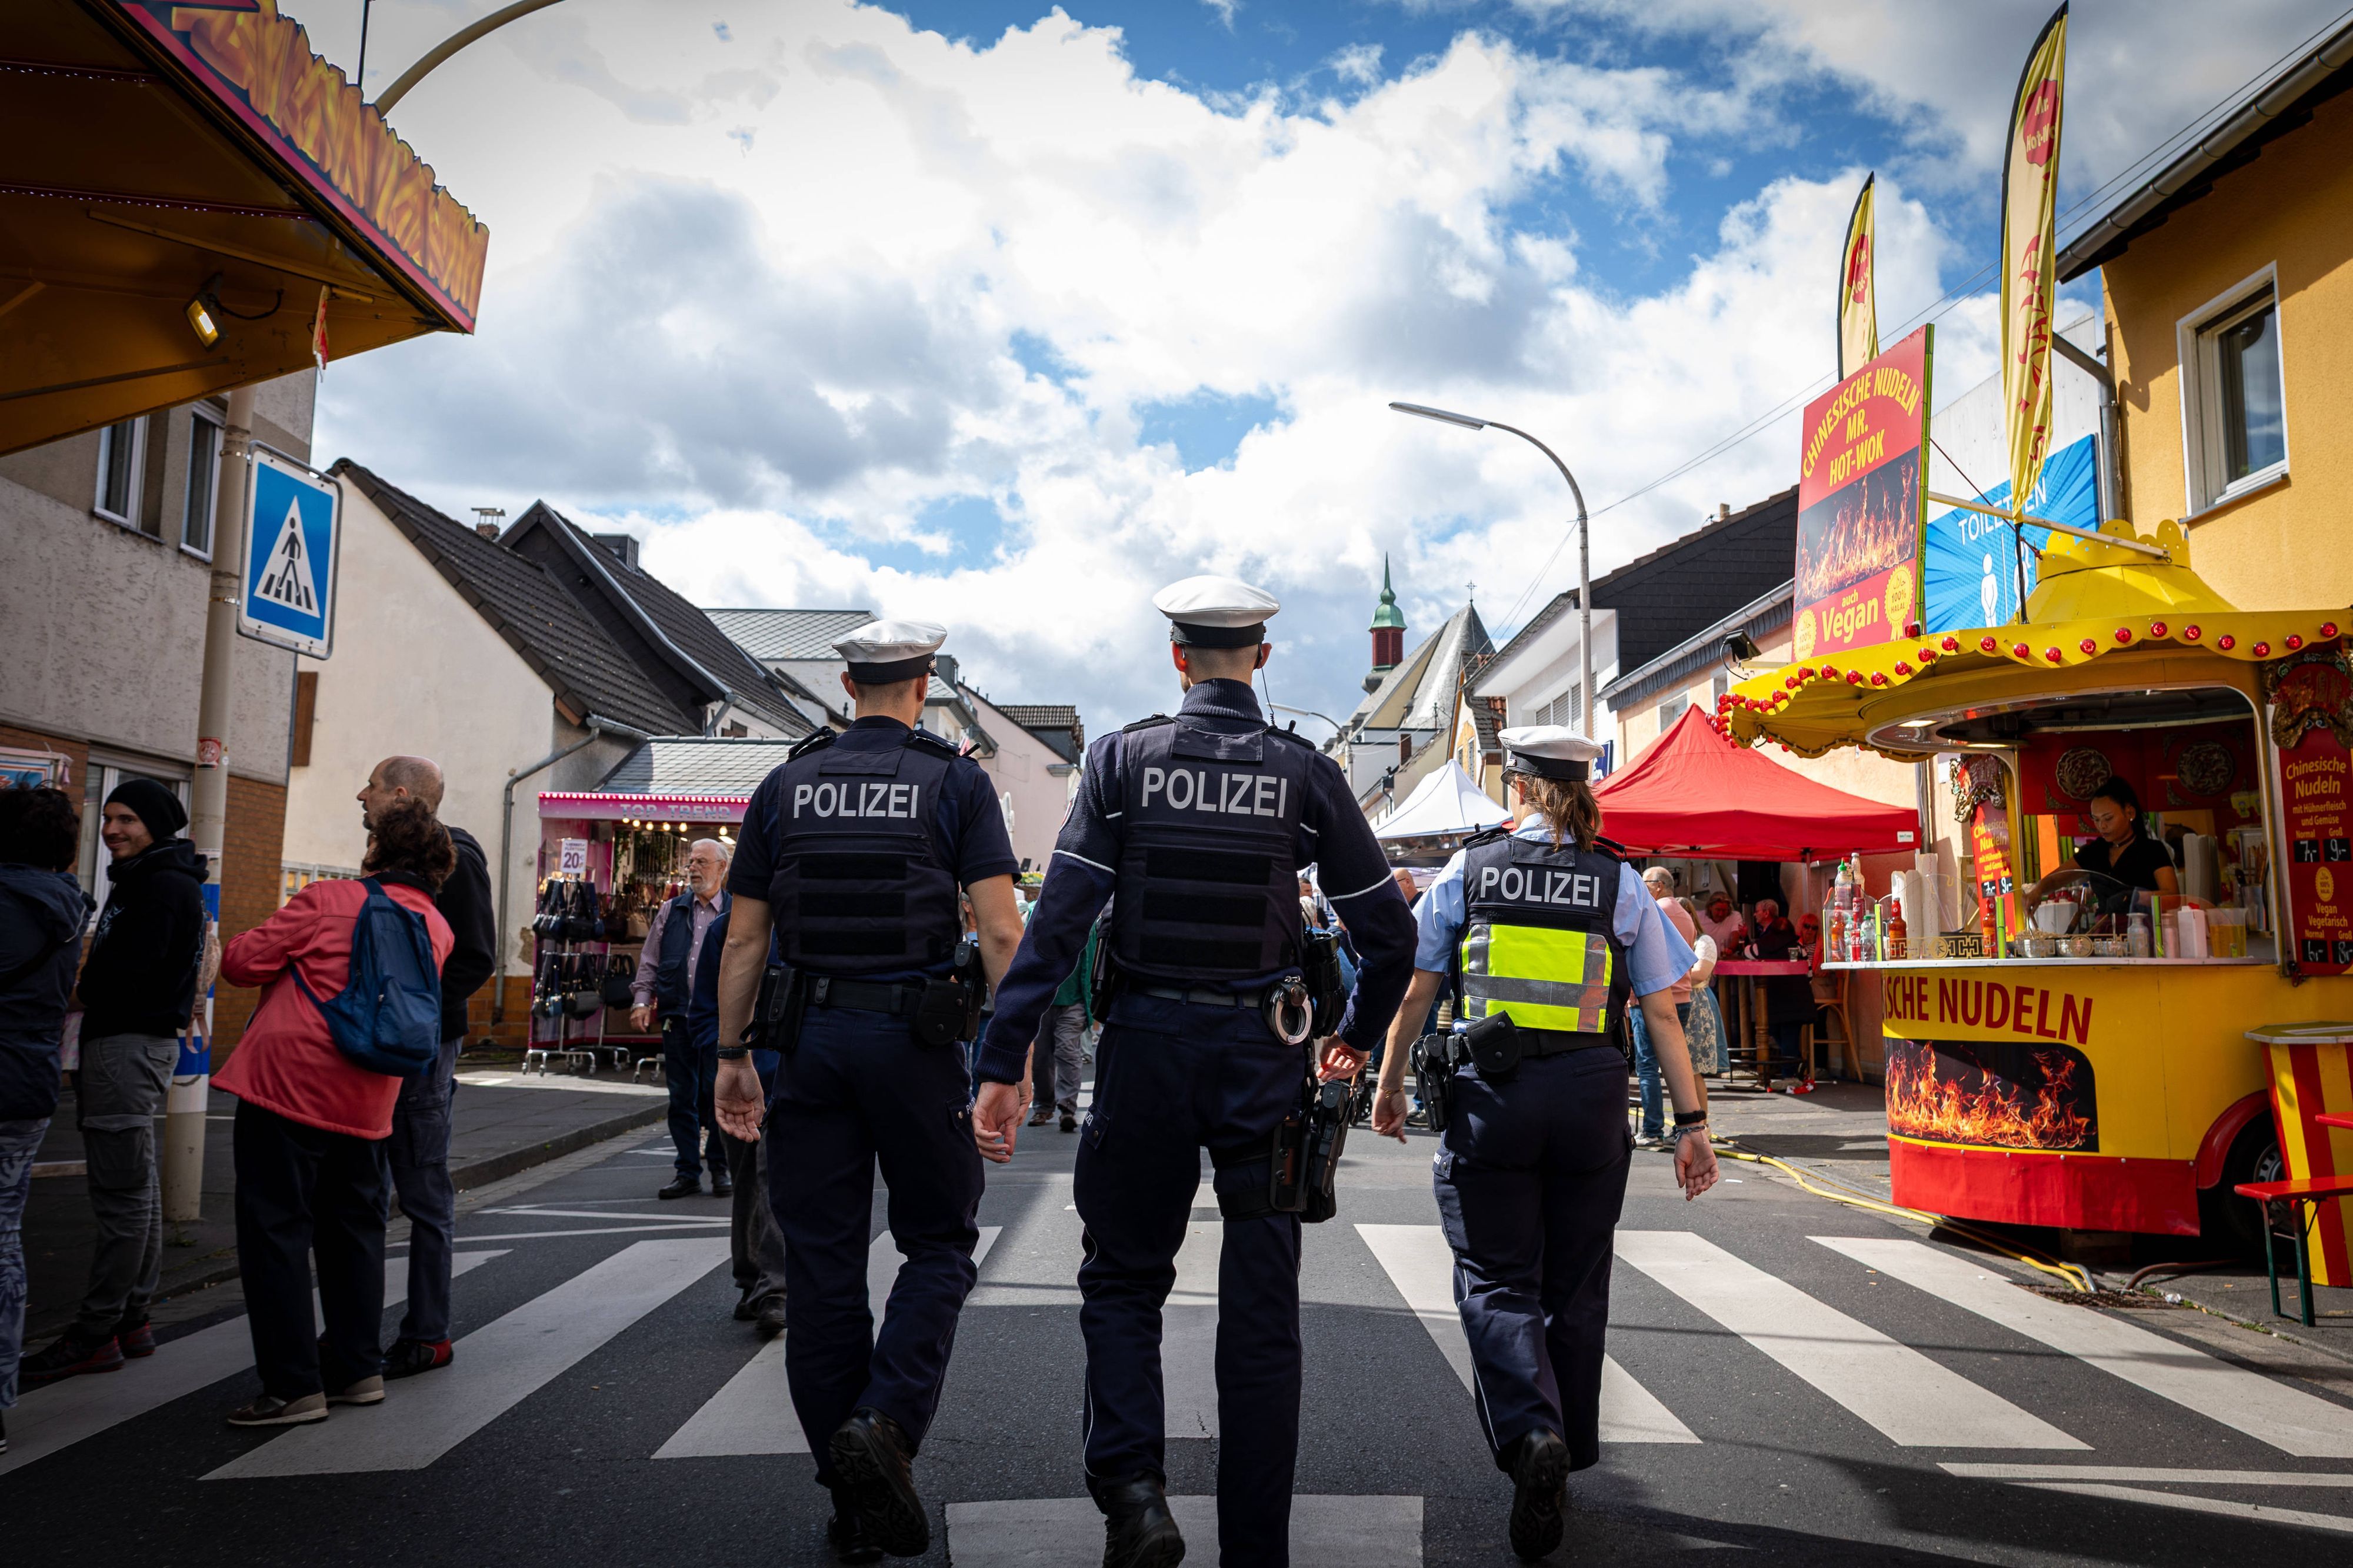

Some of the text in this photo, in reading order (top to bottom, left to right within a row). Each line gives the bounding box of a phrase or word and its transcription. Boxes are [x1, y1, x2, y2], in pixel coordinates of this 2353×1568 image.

[1802, 367, 1921, 478] CHINESISCHE NUDELN
[1846, 409, 1869, 444] MR.
[1829, 429, 1885, 487] HOT-WOK
[1958, 476, 2047, 546] TOILETEN
[1842, 589, 1859, 608] auch
[1891, 602, 1905, 613] HALAL
[1892, 589, 1907, 603] 100%
[1822, 597, 1879, 644] Vegan
[2286, 756, 2347, 780] Chinesische
[1141, 767, 1287, 818] POLIZEI
[2295, 775, 2341, 799] Nudeln
[794, 783, 919, 818] POLIZEI
[2292, 800, 2347, 814] mit Hühnerfleisch
[2301, 814, 2339, 826] und Gemüse
[2296, 827, 2343, 838] Normal Groß
[1480, 867, 1599, 907] POLIZEI
[2315, 903, 2337, 916] Vegan
[2308, 915, 2348, 929] Vegetarisch
[2305, 929, 2352, 940] Normal Groß
[1939, 978, 2094, 1045] NUDELN
